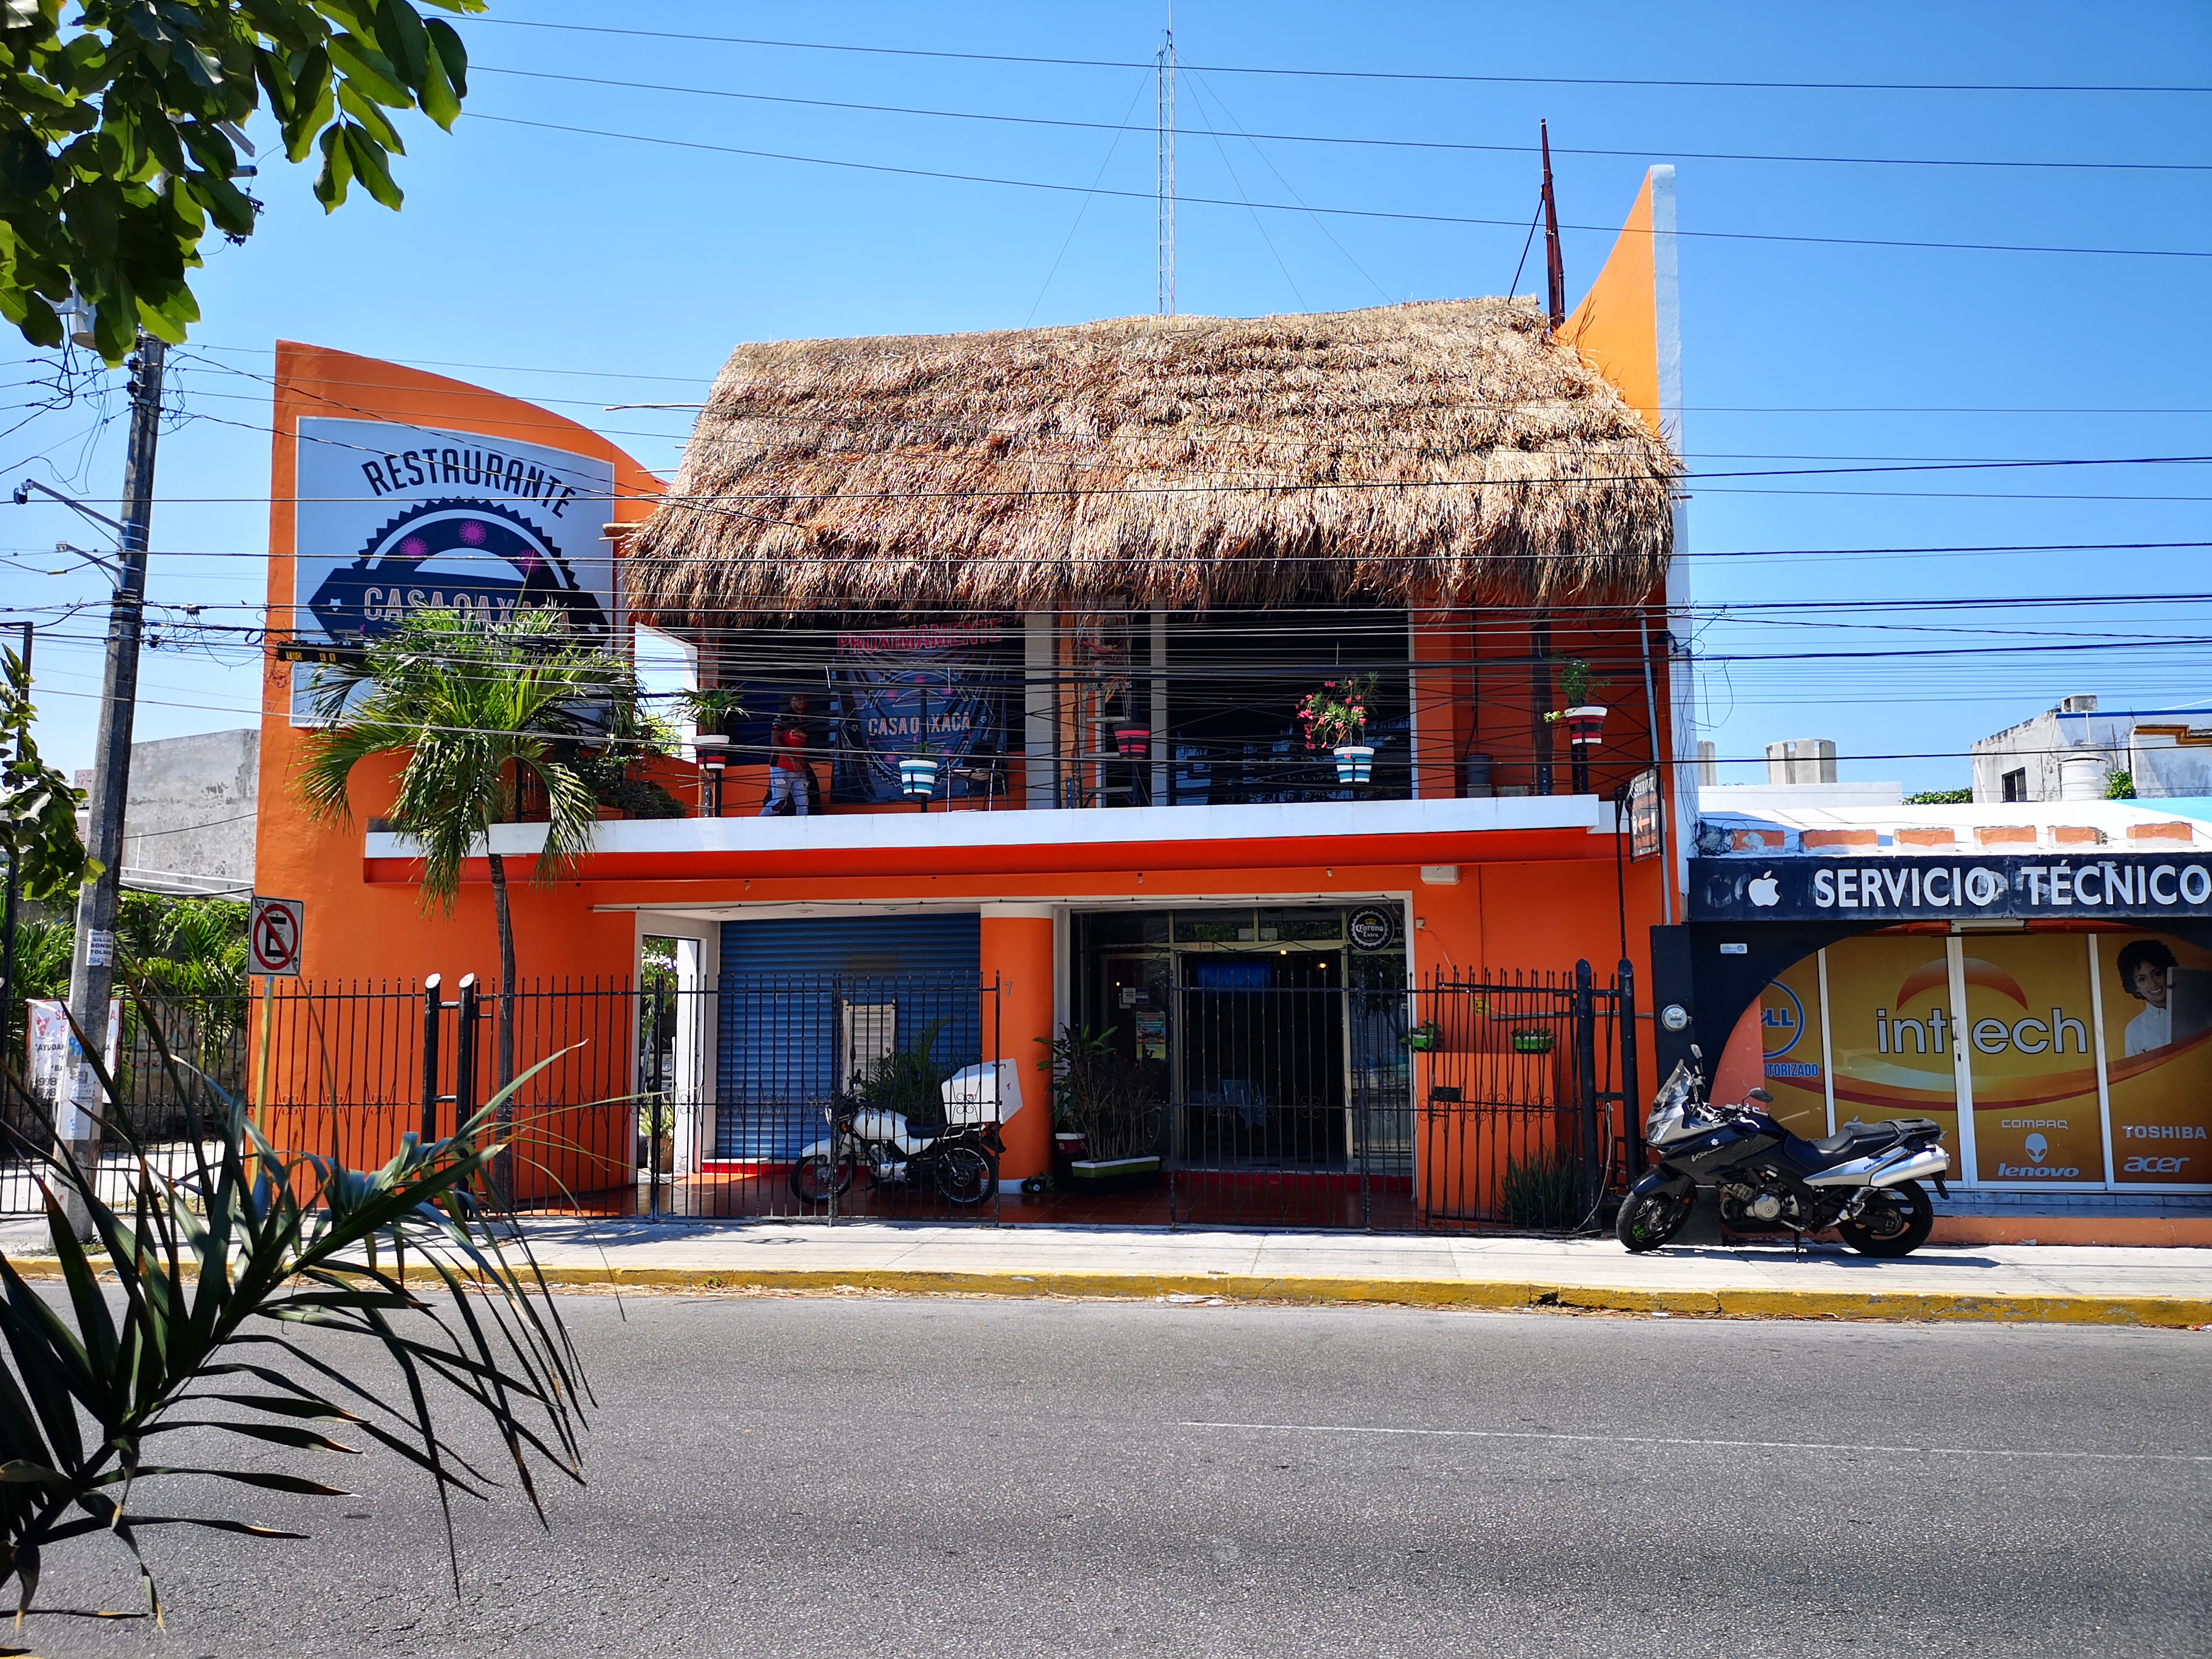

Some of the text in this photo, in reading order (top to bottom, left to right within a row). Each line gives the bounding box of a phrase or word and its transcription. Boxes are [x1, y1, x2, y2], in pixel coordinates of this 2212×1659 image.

[361, 448, 577, 519] RESTAURANTE
[1814, 859, 2212, 908] SERVICIO TÉCNICO
[1355, 923, 1384, 933] Corona
[1004, 981, 1013, 996] 7
[2002, 1119, 2068, 1130] COMPAQ
[2122, 1125, 2207, 1139] TOSHIBA
[1998, 1163, 2079, 1177] lenovo
[2123, 1156, 2191, 1173] acer
